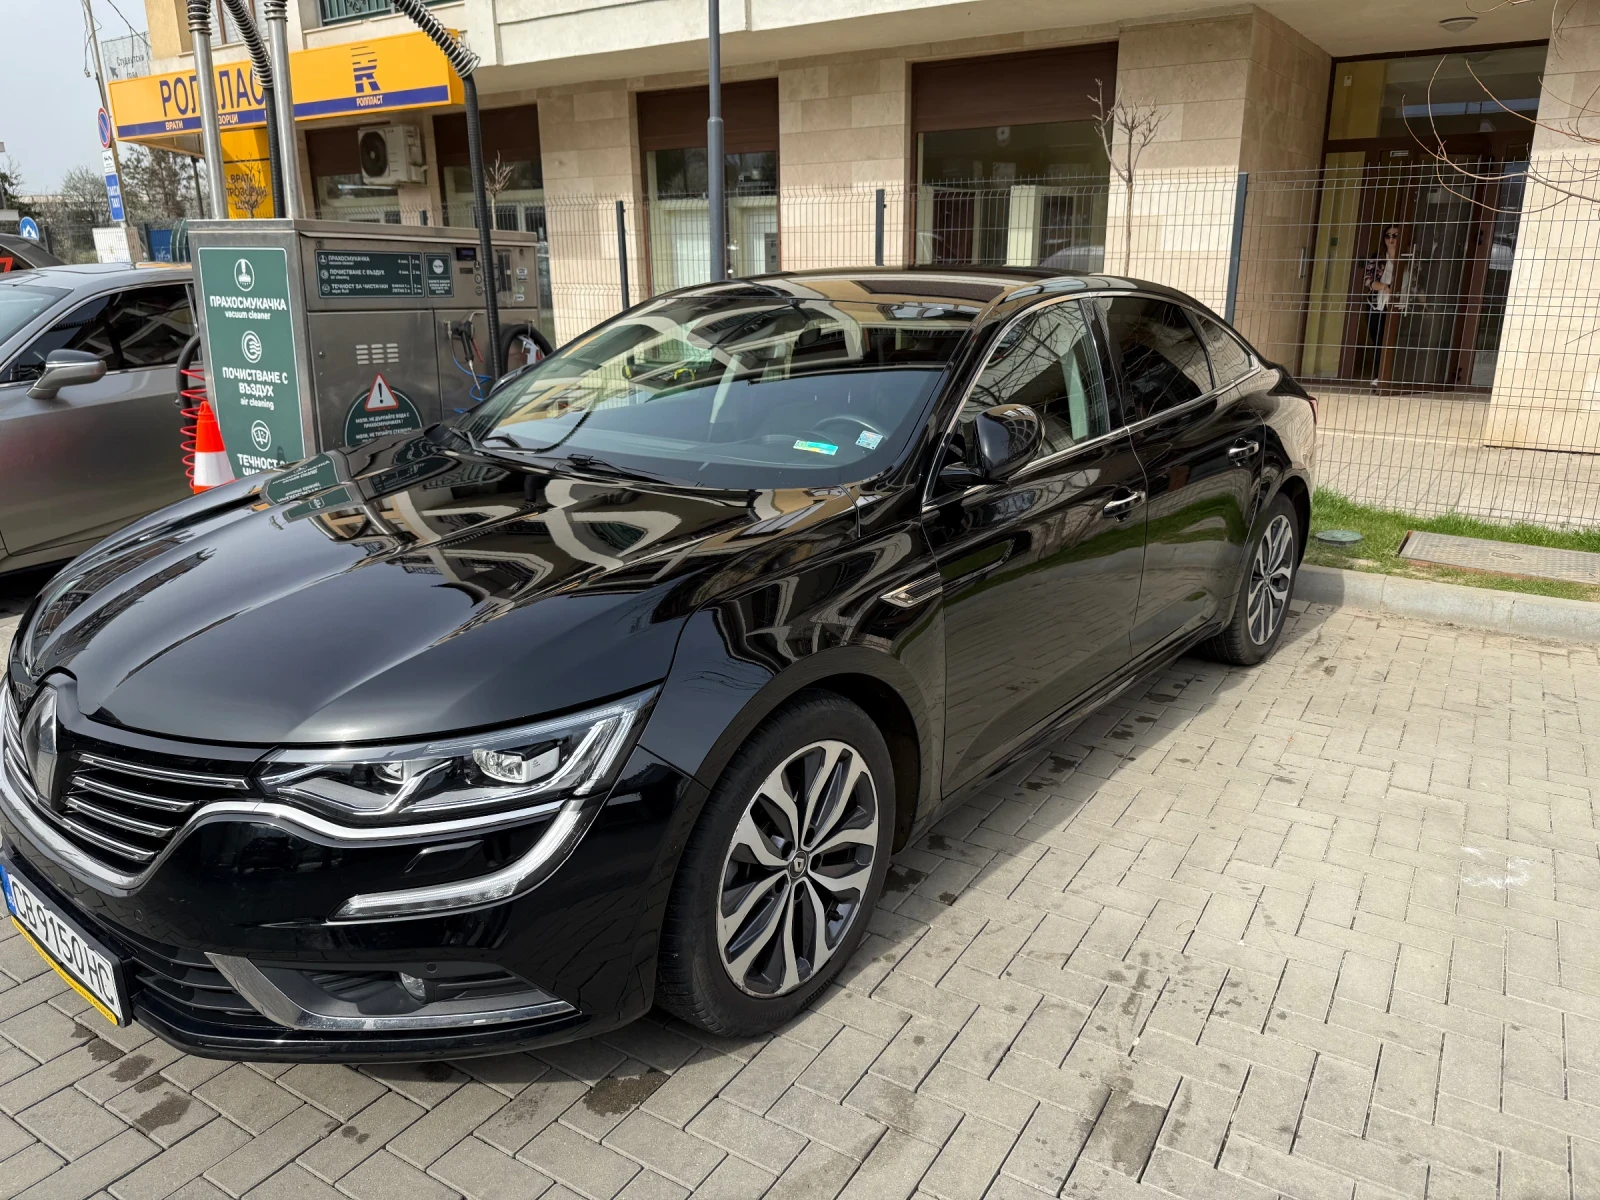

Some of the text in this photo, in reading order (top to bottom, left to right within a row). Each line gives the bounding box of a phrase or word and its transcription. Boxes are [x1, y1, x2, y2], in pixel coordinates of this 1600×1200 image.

[356, 95, 383, 107] РОЛПЛАСТ
[165, 120, 184, 131] ВРАТИ
[230, 173, 256, 183] ВРАТИ
[209, 295, 288, 311] ПРАХОСМУКАЧКА
[224, 310, 271, 320] vacuum cleaner
[222, 366, 289, 384] ПОЧИСТВАНЕ С
[238, 382, 274, 398] ВЪЗДУХ
[240, 396, 275, 411] air cleaning
[237, 453, 278, 470] ТЕЧНОСТ
